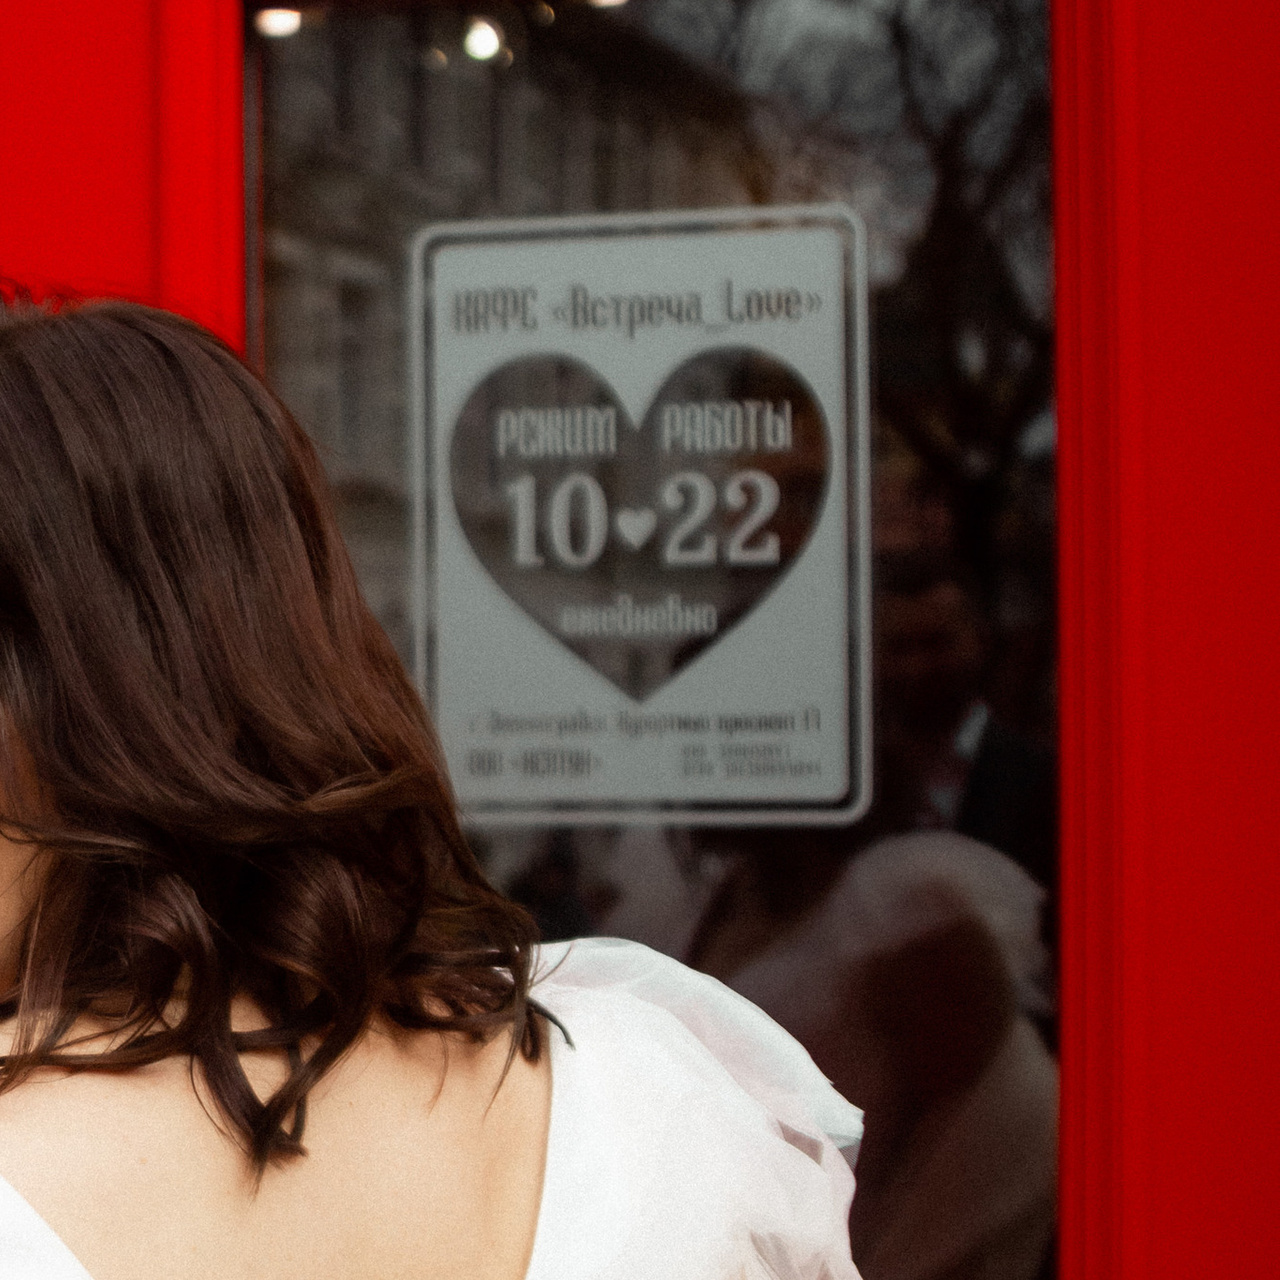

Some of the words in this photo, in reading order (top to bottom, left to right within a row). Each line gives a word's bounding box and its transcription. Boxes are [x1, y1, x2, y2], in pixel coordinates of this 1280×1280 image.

[451, 285, 539, 334] КАФЕ
[495, 406, 618, 458] РЕЖИМ
[661, 399, 794, 455] РАБОТЫ
[505, 471, 610, 569] 10
[660, 468, 782, 566] 22
